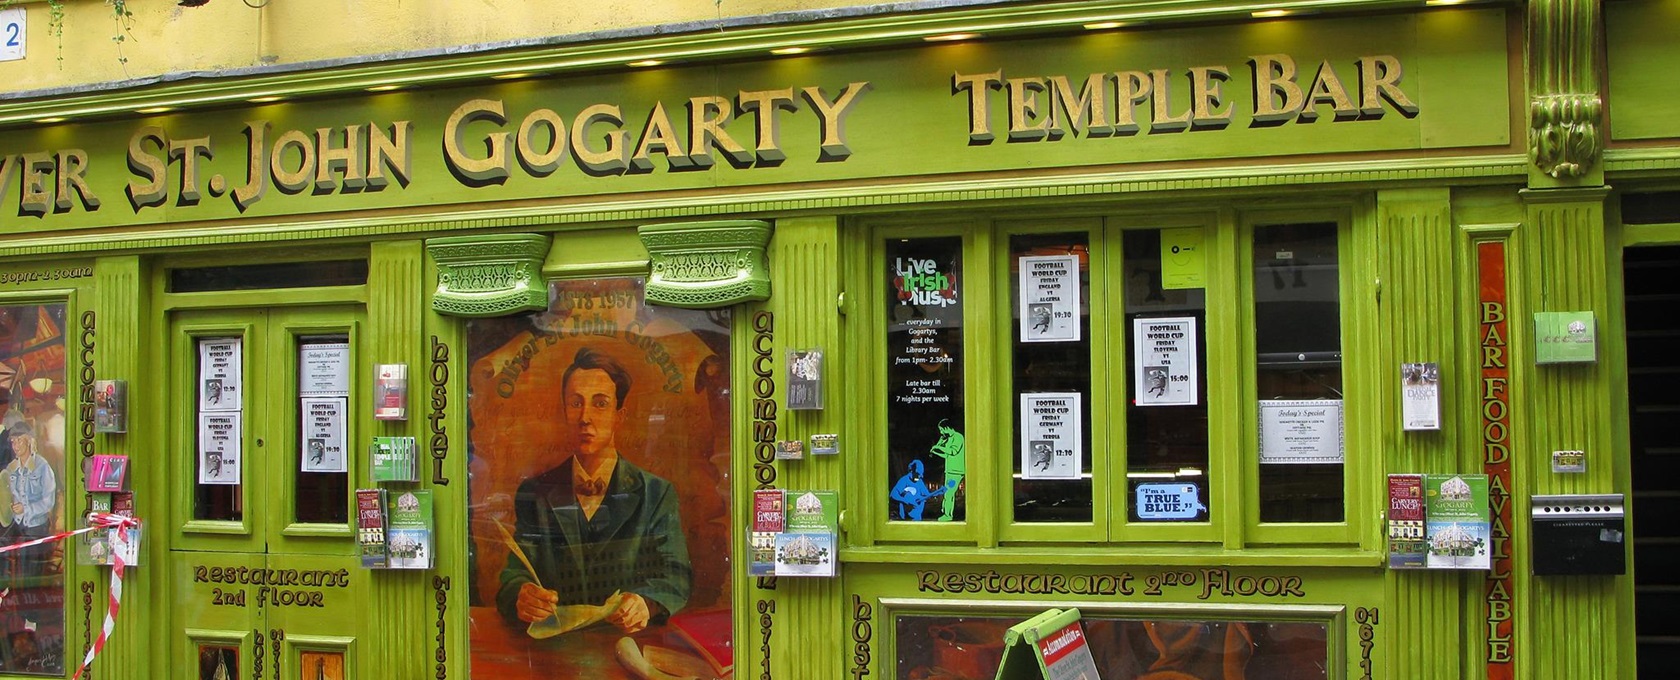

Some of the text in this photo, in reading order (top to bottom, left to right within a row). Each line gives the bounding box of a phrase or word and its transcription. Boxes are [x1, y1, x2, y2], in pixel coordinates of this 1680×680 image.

[6, 22, 19, 47] 2
[952, 53, 1420, 146] TEMPLE BAR
[231, 119, 414, 214] JOHN
[443, 81, 873, 188] GOGARTY
[896, 257, 937, 278] Live
[904, 269, 949, 291] Irish
[906, 318, 934, 327] everyday
[935, 317, 941, 325] in
[496, 336, 540, 399] Oliver
[570, 314, 619, 339] John
[625, 320, 685, 395] Gogarty
[895, 356, 911, 365] from
[906, 347, 928, 355] Library
[901, 395, 920, 404] nights
[428, 336, 449, 486] hostel
[1303, 409, 1326, 417] Special
[1482, 302, 1511, 663] BAR FOOD AVAILABLE
[93, 500, 109, 511] BAR
[1145, 494, 1181, 503] TRUE
[193, 565, 349, 587] Restaurant
[917, 568, 1134, 596] Restaurant
[1200, 568, 1305, 599] Floor
[212, 588, 324, 608] 2nd floor
